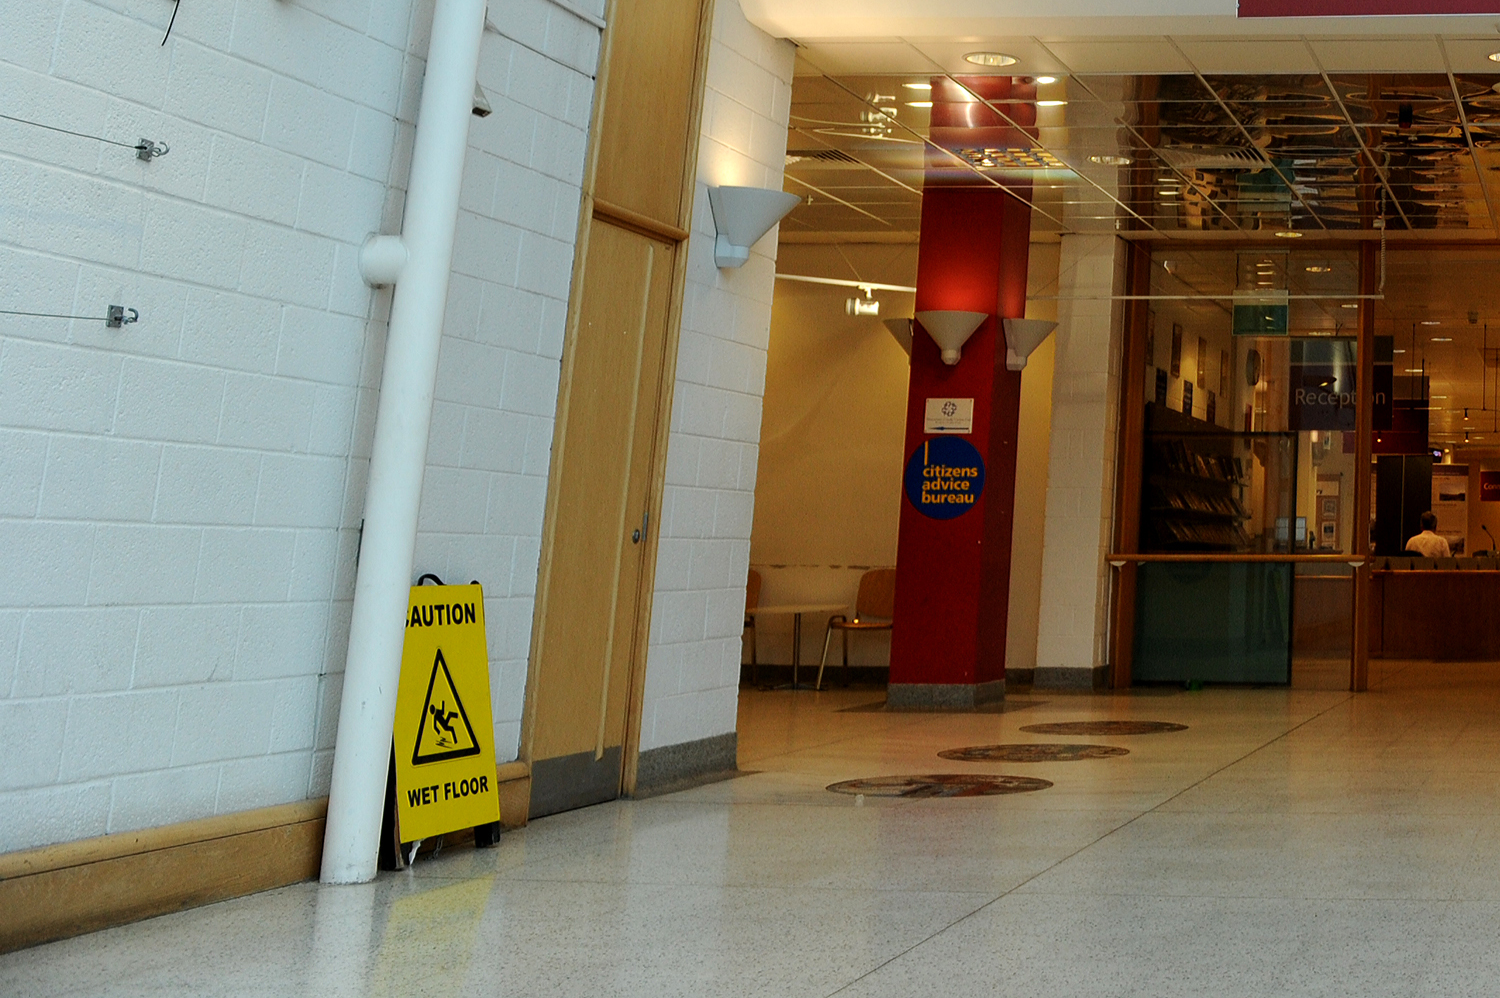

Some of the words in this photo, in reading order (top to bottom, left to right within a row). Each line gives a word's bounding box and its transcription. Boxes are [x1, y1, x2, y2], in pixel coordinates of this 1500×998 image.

[1295, 388, 1386, 410] Receptn
[922, 464, 978, 477] citizens
[922, 477, 970, 490] advice
[922, 490, 974, 504] bureau
[407, 785, 439, 808] WET
[444, 775, 489, 801] FLOOR
